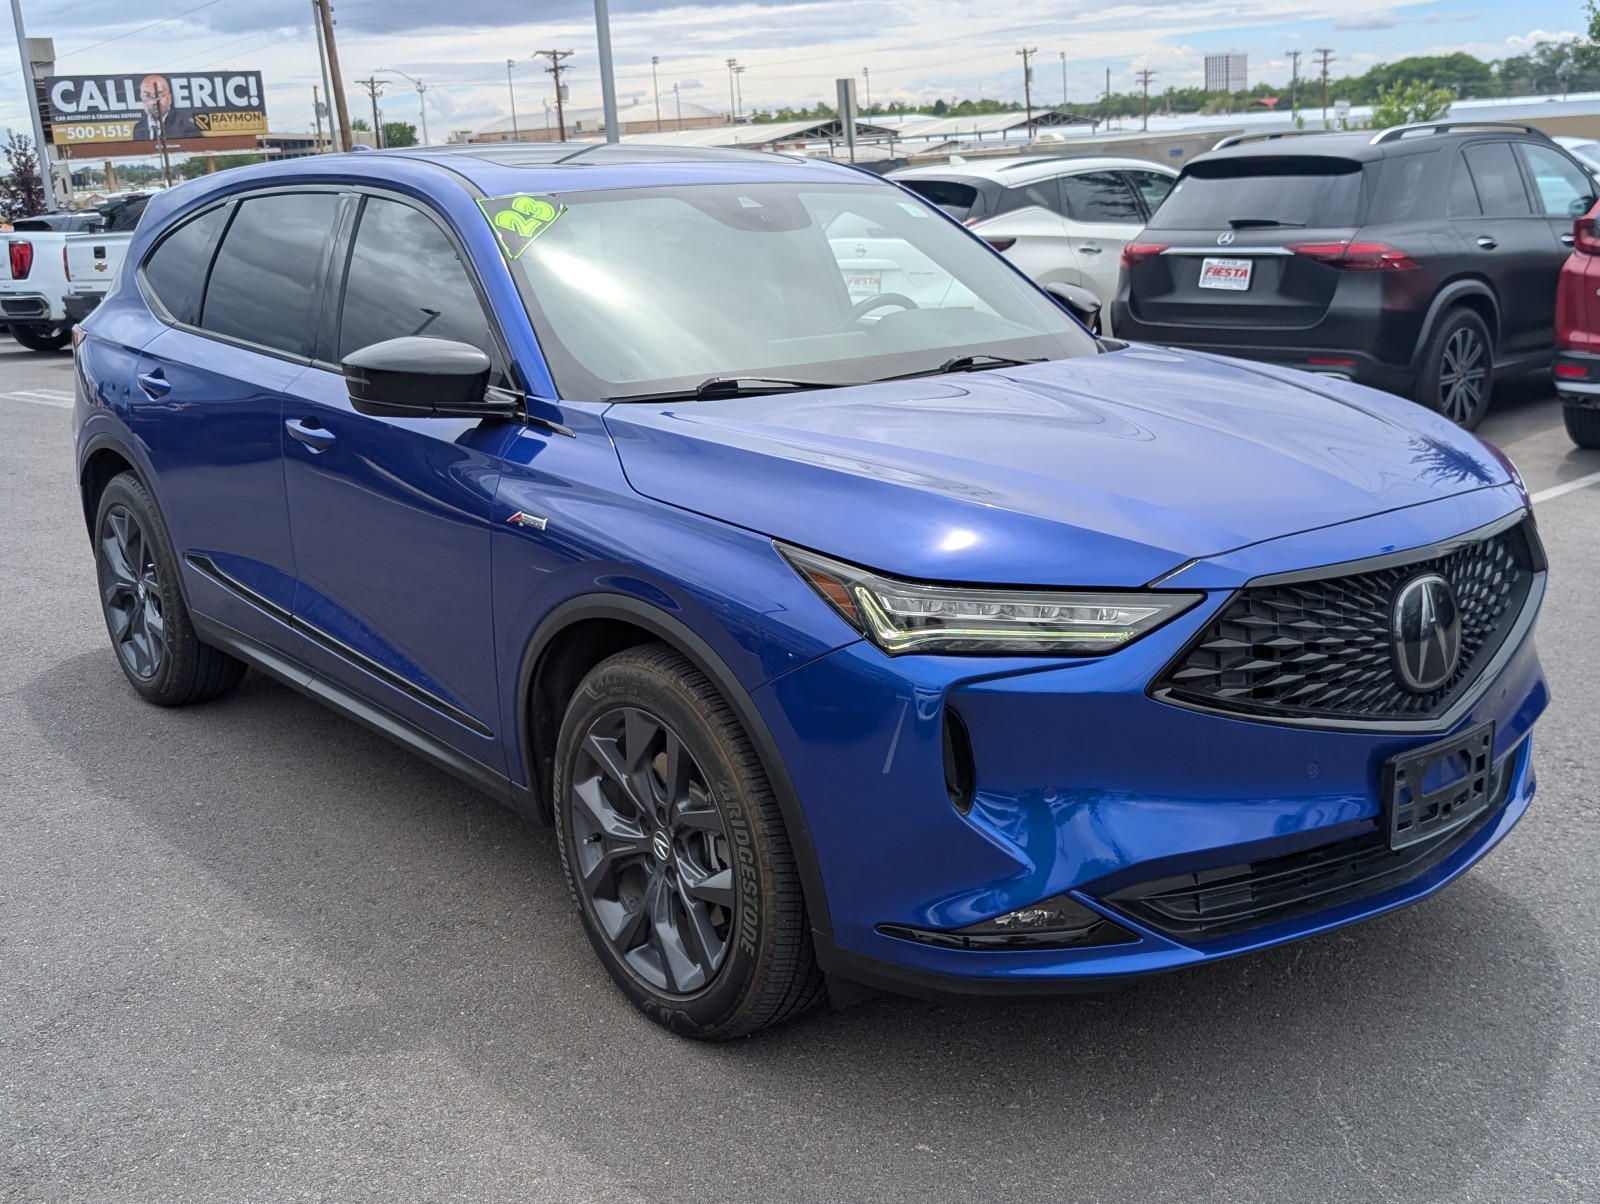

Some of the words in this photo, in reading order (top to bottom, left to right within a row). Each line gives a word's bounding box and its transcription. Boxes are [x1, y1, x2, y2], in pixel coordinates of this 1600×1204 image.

[51, 79, 143, 112] CALL
[171, 76, 260, 109] ERIC!
[211, 112, 261, 123] RAYMON
[67, 124, 132, 140] 500-1515
[1205, 266, 1248, 278] FIESTA
[848, 277, 880, 286] FIESTA
[717, 780, 759, 958] BRIDGESTONE
